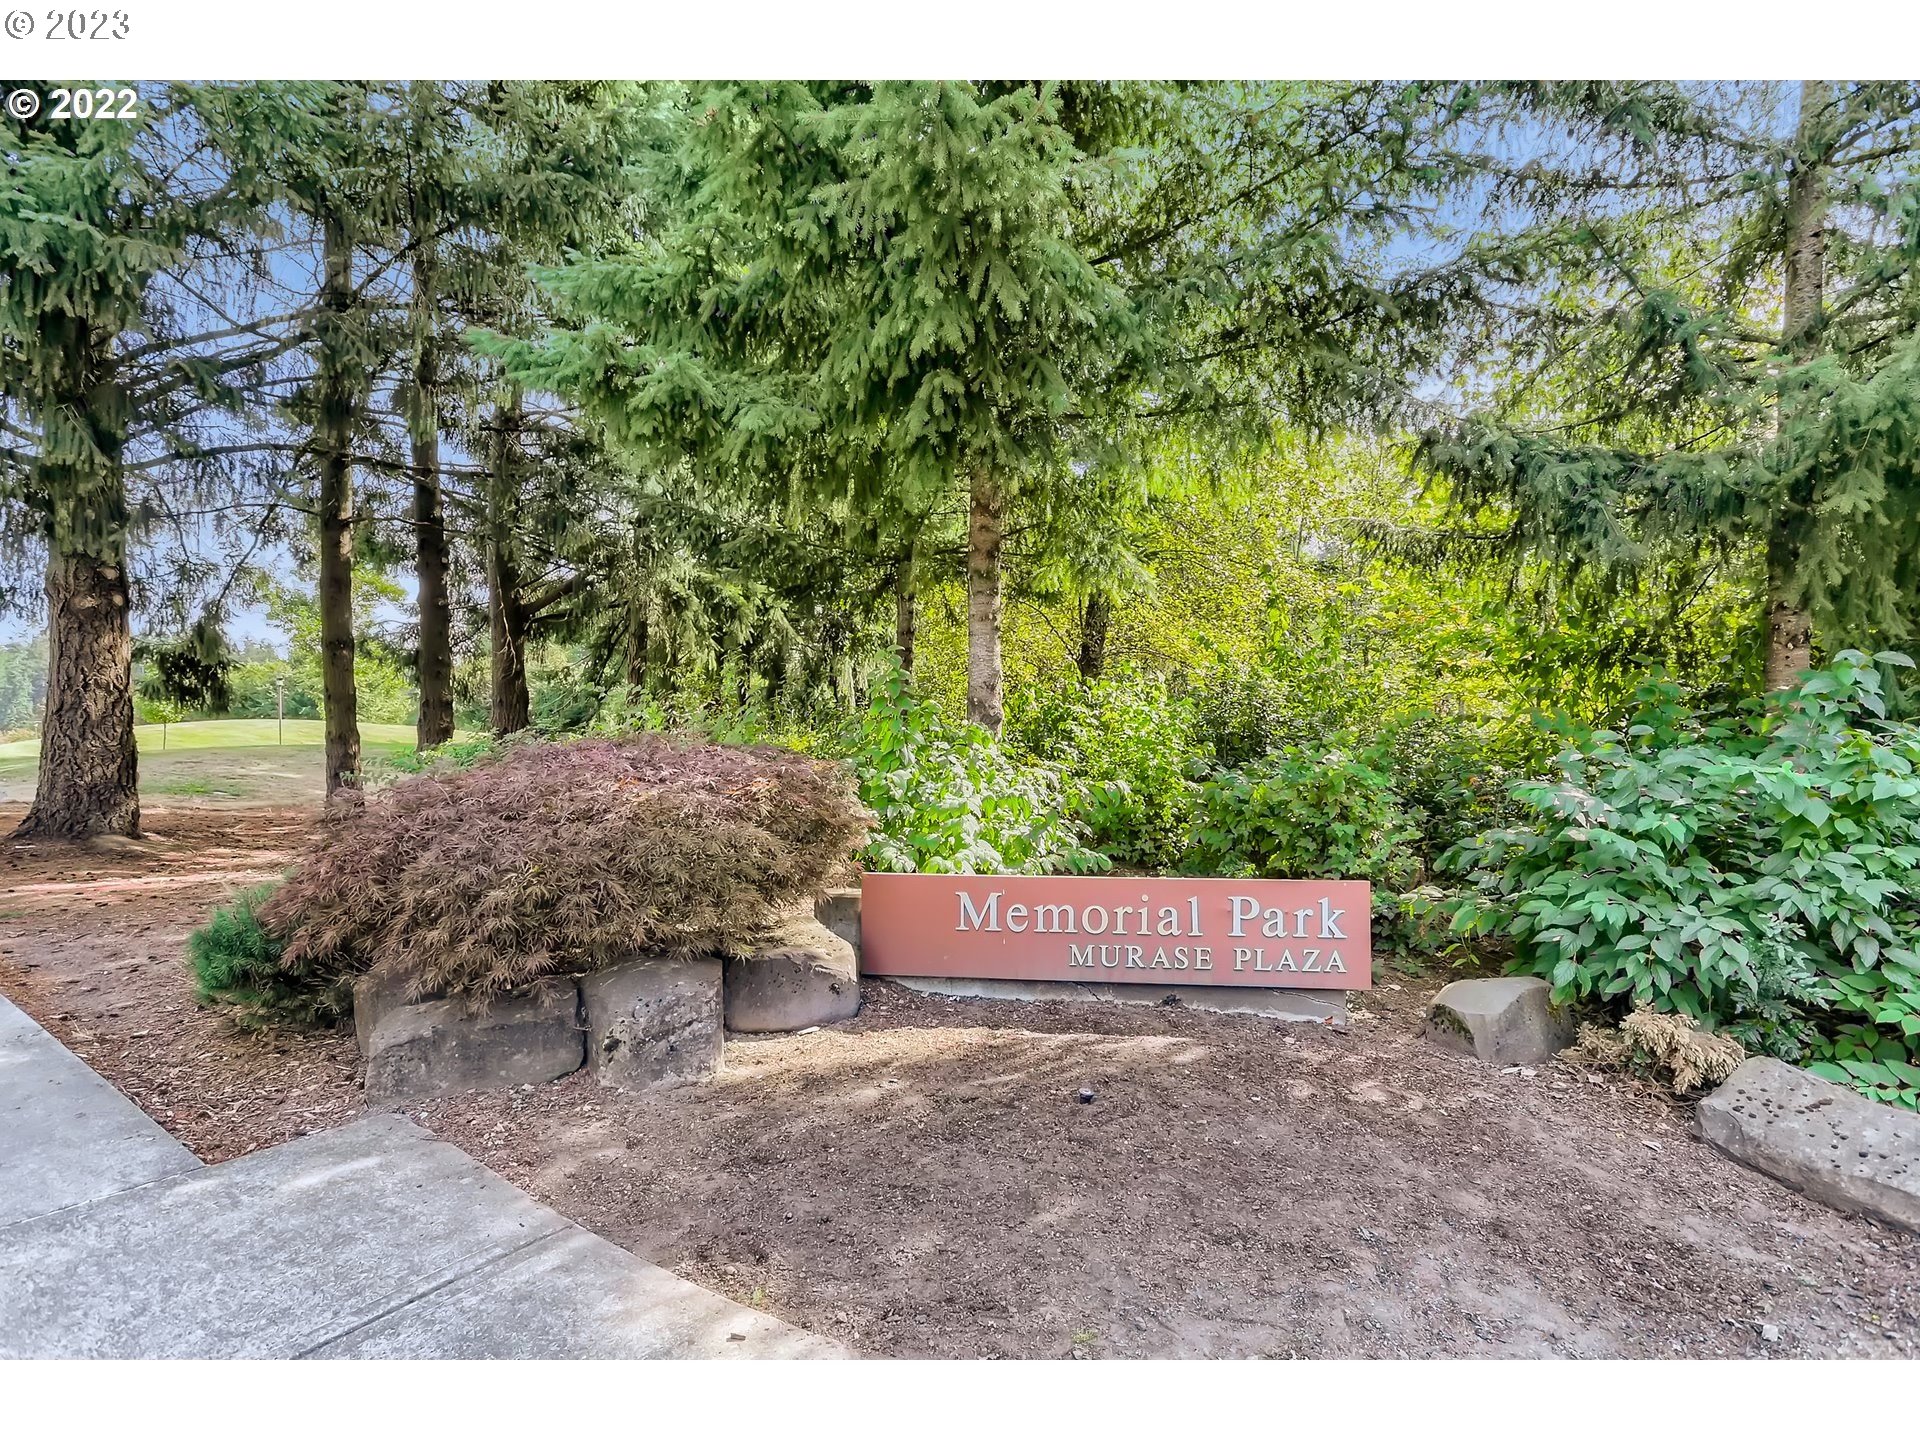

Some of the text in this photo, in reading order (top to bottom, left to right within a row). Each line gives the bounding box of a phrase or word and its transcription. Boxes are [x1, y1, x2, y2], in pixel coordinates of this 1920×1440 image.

[954, 891, 1348, 940] Memorial Park
[1068, 944, 1348, 974] MURASE PLAZA
